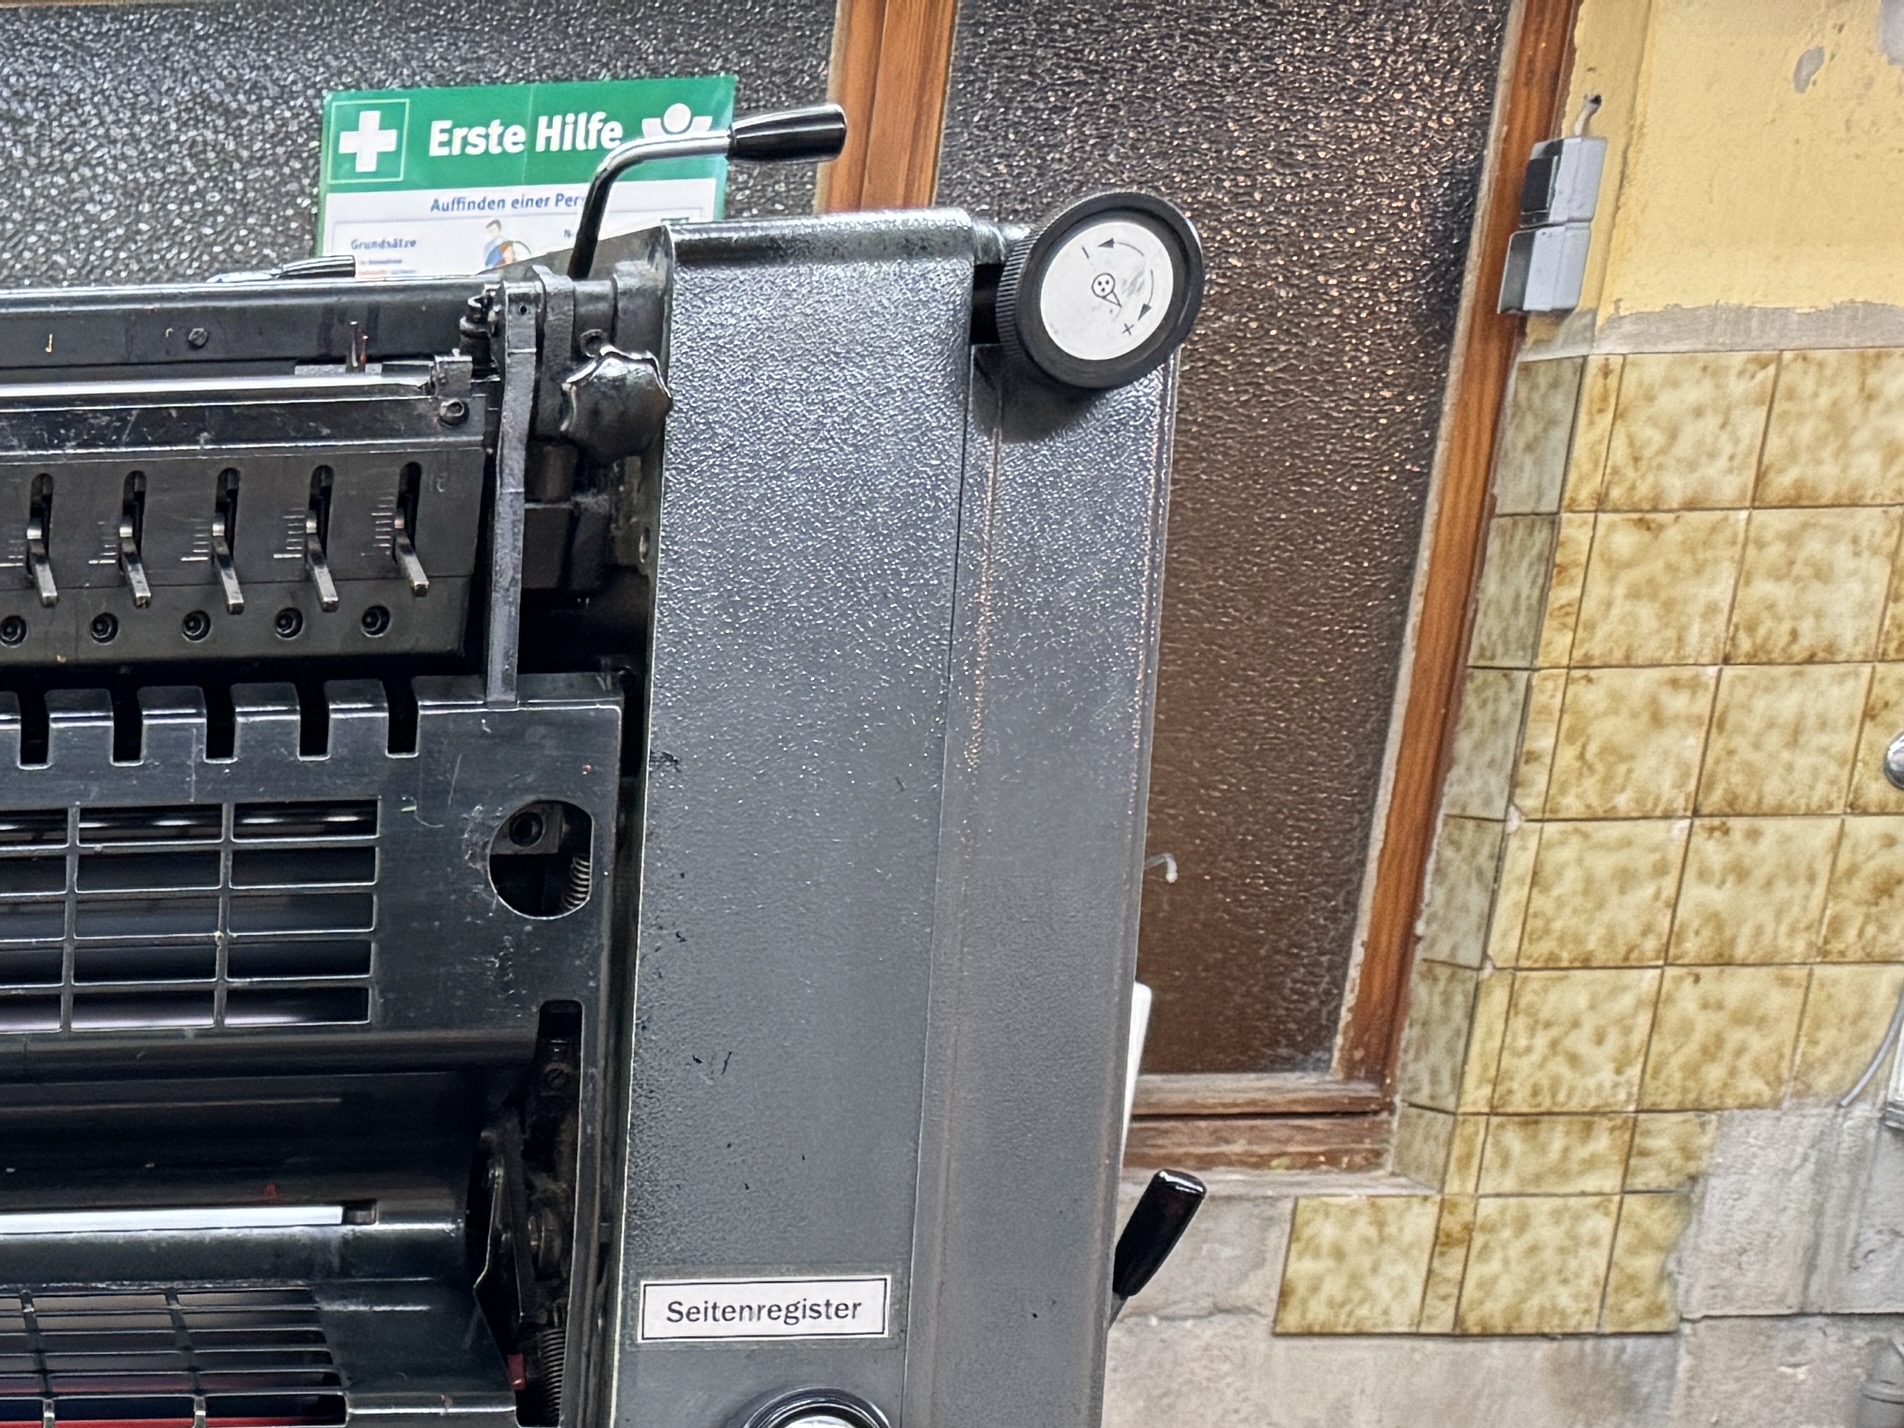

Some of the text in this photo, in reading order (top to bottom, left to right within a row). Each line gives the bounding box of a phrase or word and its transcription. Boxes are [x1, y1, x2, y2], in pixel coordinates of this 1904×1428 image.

[429, 111, 624, 157] Erste Hilfe
[430, 196, 506, 212] Auffinden
[511, 194, 550, 208] einer
[666, 1297, 862, 1325] Seitenregister
